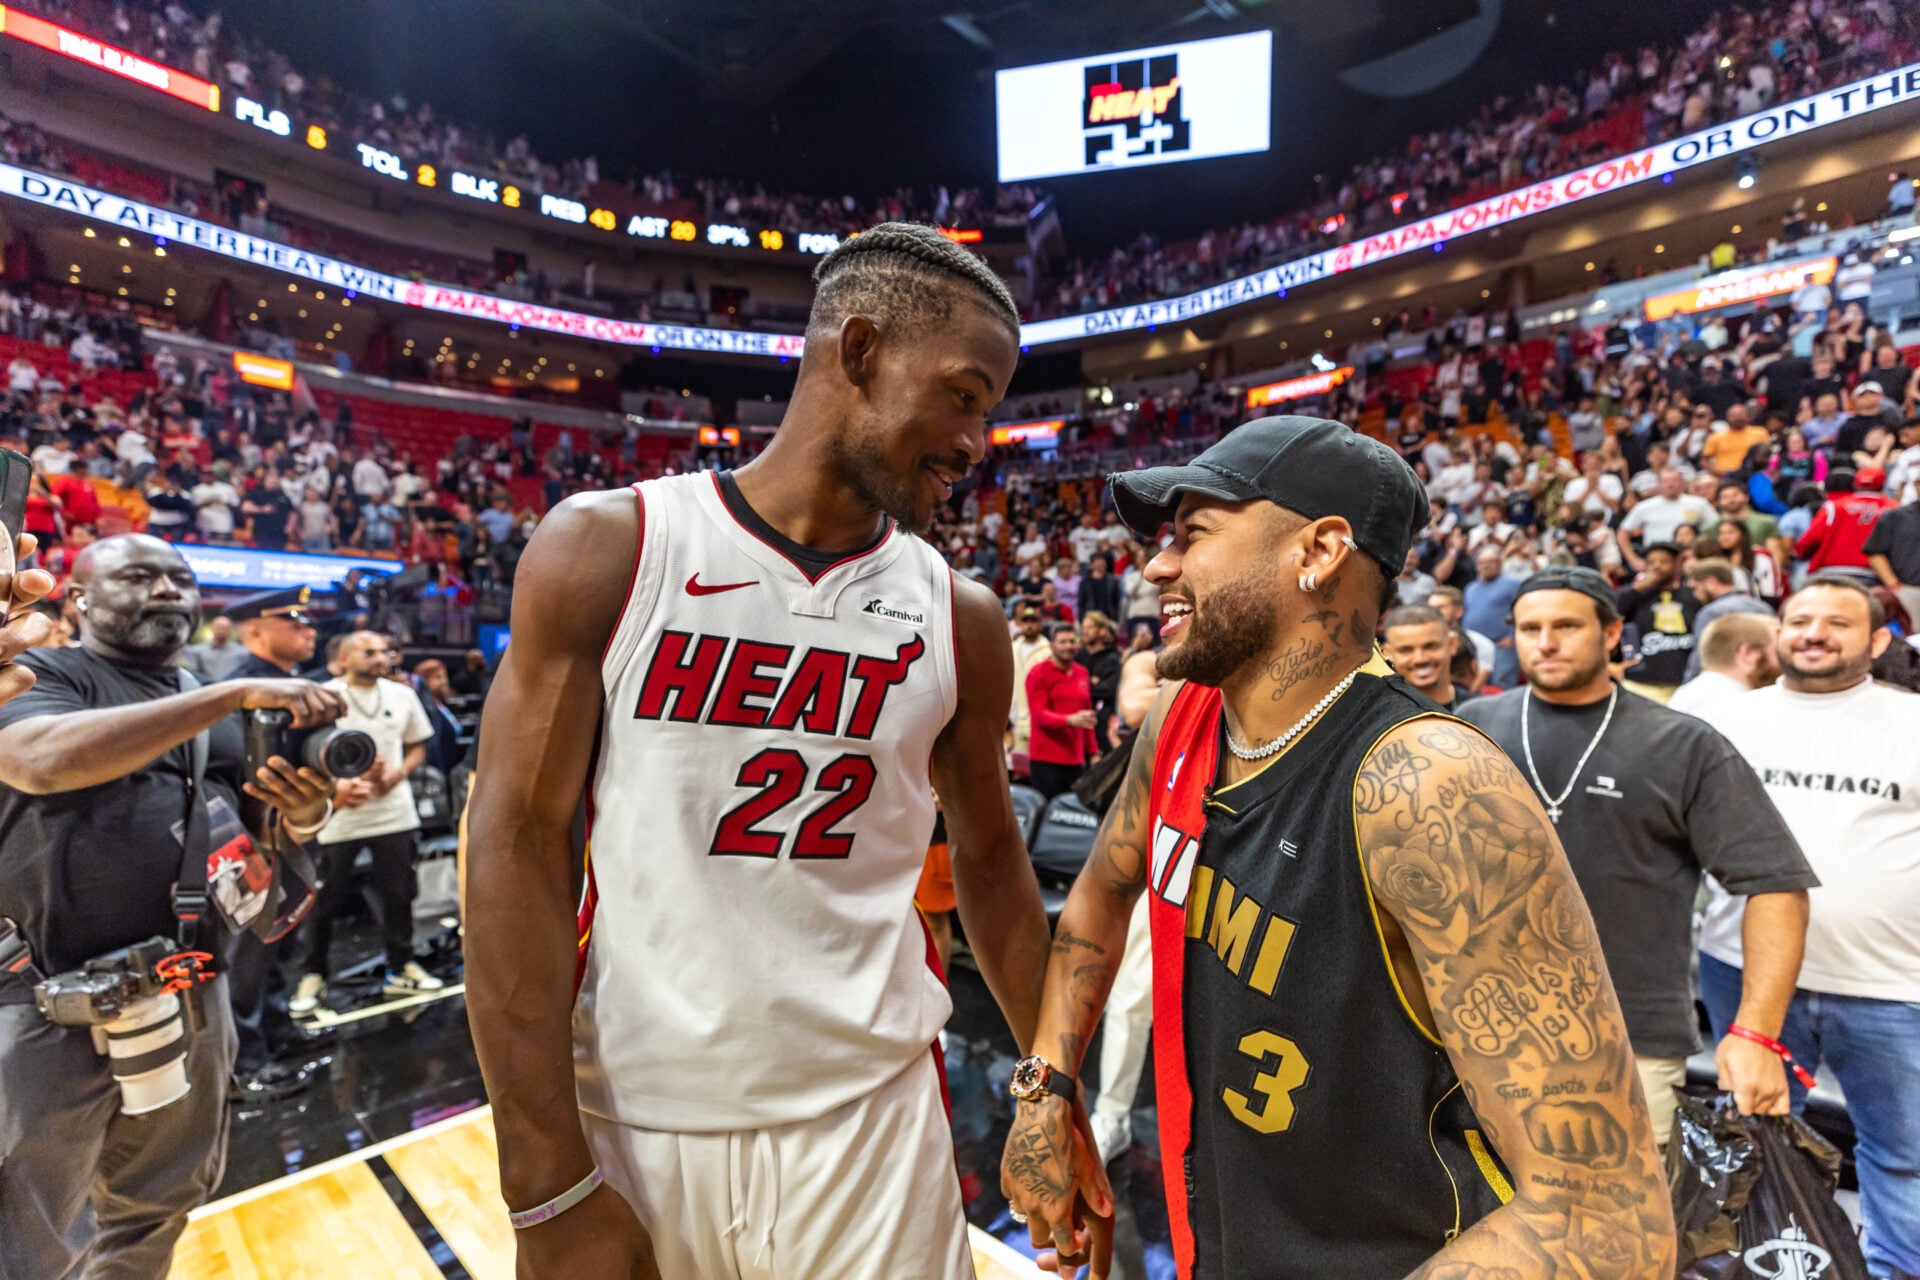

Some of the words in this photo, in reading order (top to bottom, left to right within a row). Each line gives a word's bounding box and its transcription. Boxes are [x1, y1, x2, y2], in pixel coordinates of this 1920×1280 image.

[1089, 77, 1179, 122] HEAT
[357, 143, 408, 180] TOL
[452, 171, 498, 203] BLK
[541, 194, 586, 223] REB
[628, 215, 669, 238] AST
[1084, 312, 1126, 333] DAY
[1133, 299, 1201, 323] AFTER
[1210, 277, 1266, 306] HEAT
[1276, 254, 1325, 285] WIN
[1672, 130, 1733, 162] OR
[1748, 103, 1816, 139] ON
[22, 176, 102, 213] DAY
[118, 206, 237, 251] AFTER
[248, 241, 326, 277] HEAT
[340, 268, 395, 296] WIN
[655, 327, 684, 346] OR
[693, 329, 723, 347] ON
[728, 333, 770, 352] THE
[877, 606, 923, 623] Carnival
[633, 630, 925, 740] HEAT
[709, 747, 877, 859] 22
[1222, 1029, 1312, 1136] 3
